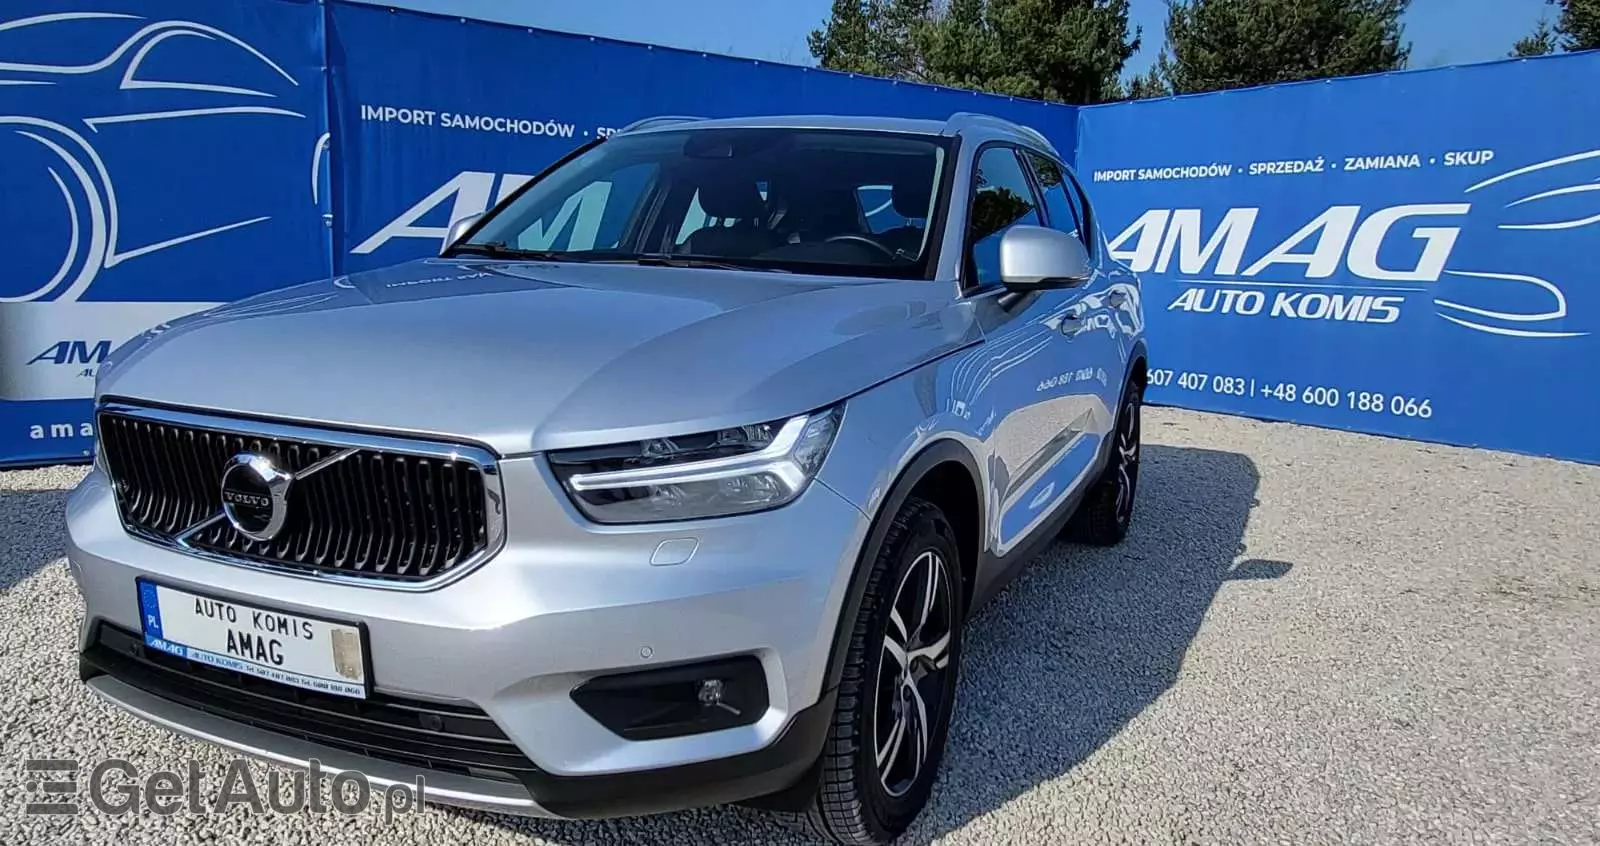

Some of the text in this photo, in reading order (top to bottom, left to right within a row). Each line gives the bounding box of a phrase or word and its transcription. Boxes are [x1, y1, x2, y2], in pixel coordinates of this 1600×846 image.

[361, 105, 436, 126] IMPORT
[440, 112, 575, 138] SAMOCHODÓW
[1094, 149, 1494, 182] IMPORT SAMOCHODÓW SPRZEDAŻ ZAMIANA SKUP
[1108, 203, 1472, 281] AMAG
[1167, 288, 1405, 324] AUTO KOMIS
[1177, 371, 1209, 391] 407
[1212, 375, 1245, 396] 083
[1260, 383, 1297, 402] +48
[1302, 386, 1339, 407] 600
[1347, 391, 1384, 413] 188
[1390, 396, 1433, 418] 066
[224, 491, 270, 507] VOLVO
[147, 614, 159, 629] PL
[194, 597, 314, 641] AUTO KOMIS
[226, 628, 285, 667] AMAG
